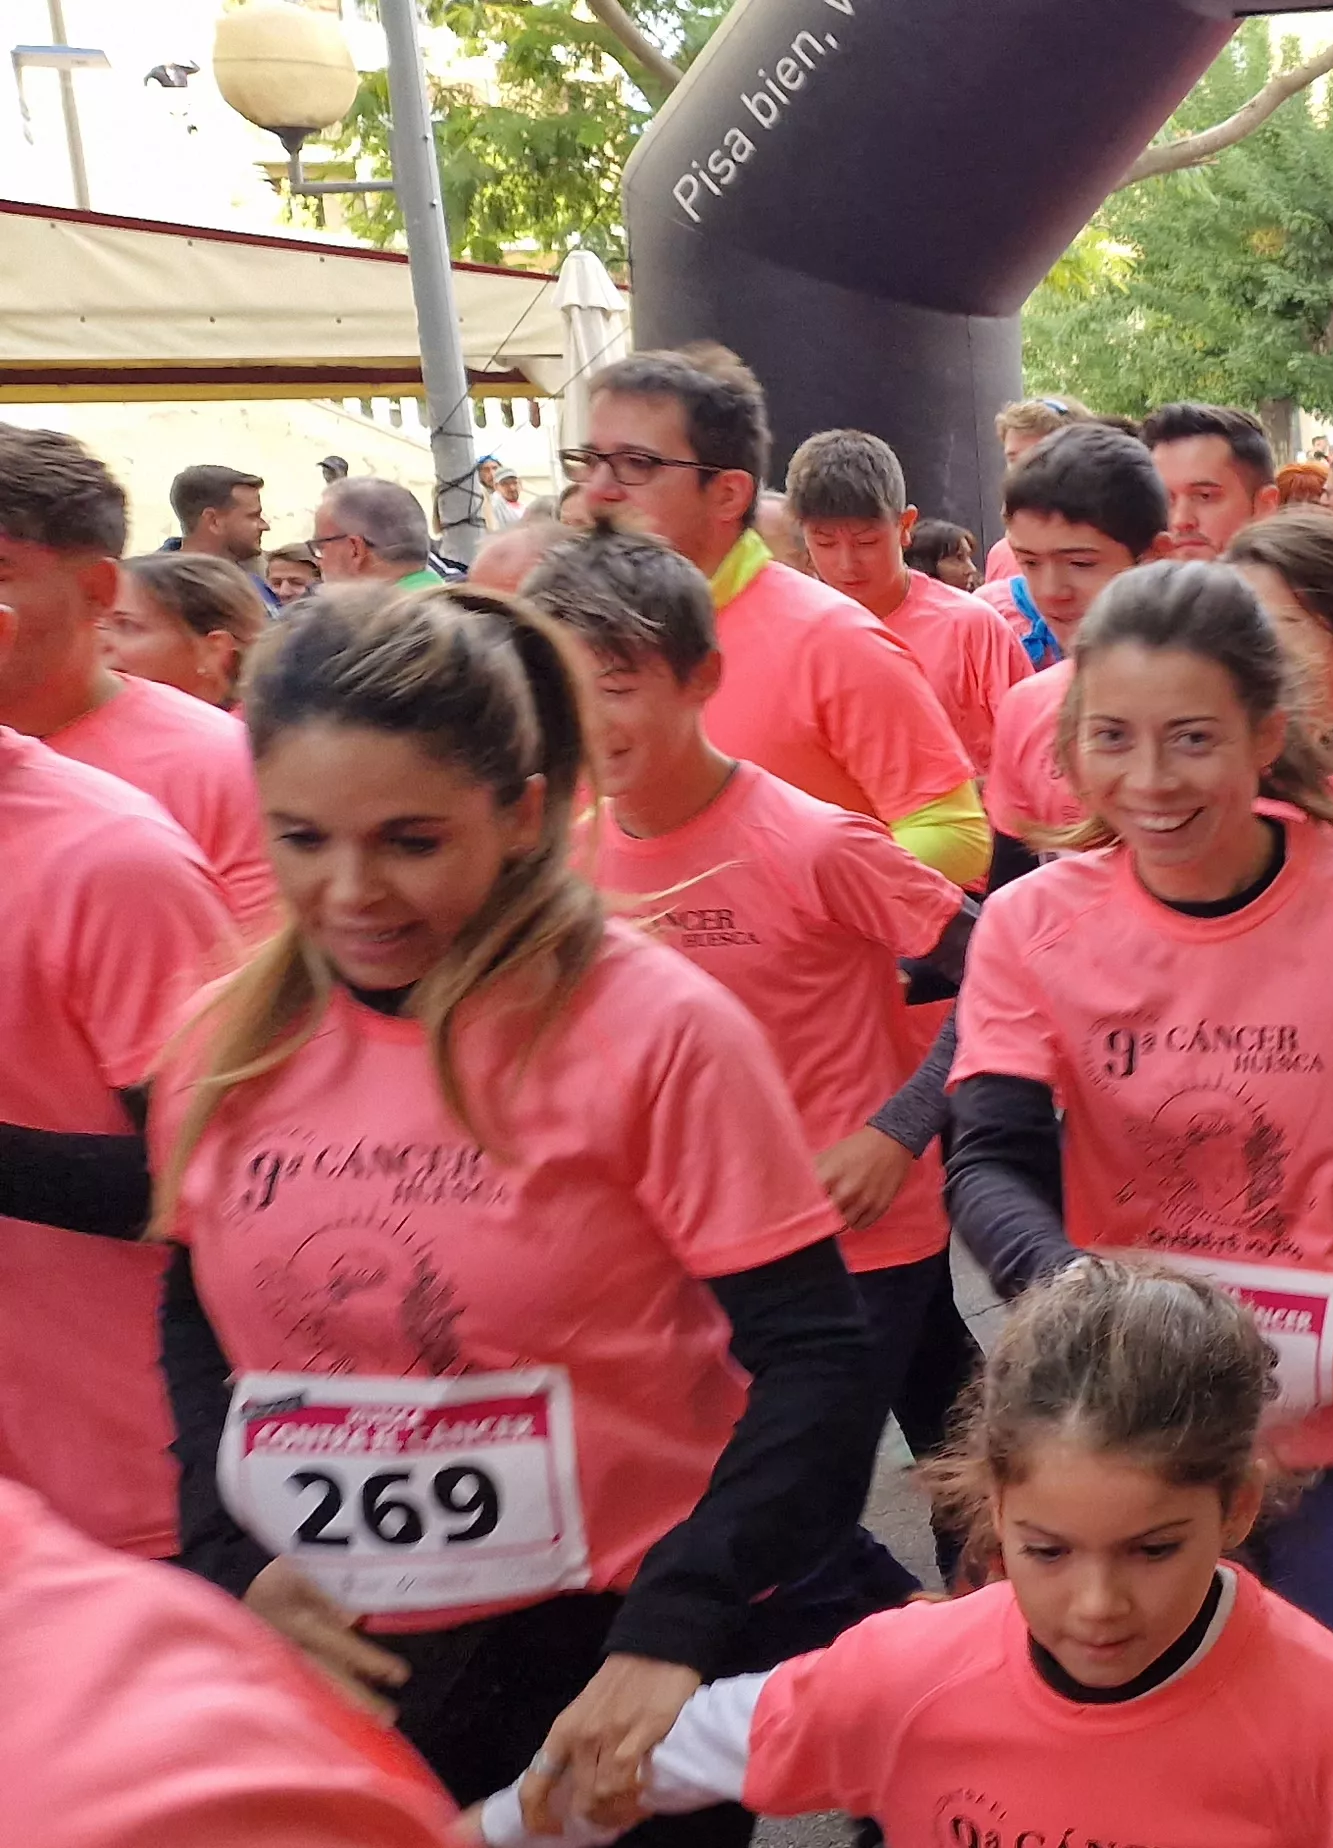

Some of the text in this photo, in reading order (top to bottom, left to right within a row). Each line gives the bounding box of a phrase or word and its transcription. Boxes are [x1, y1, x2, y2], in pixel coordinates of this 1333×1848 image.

[673, 30, 840, 223] Pisa bien,
[1165, 1018, 1299, 1051] CÁNCER
[286, 1466, 499, 1546] 269
